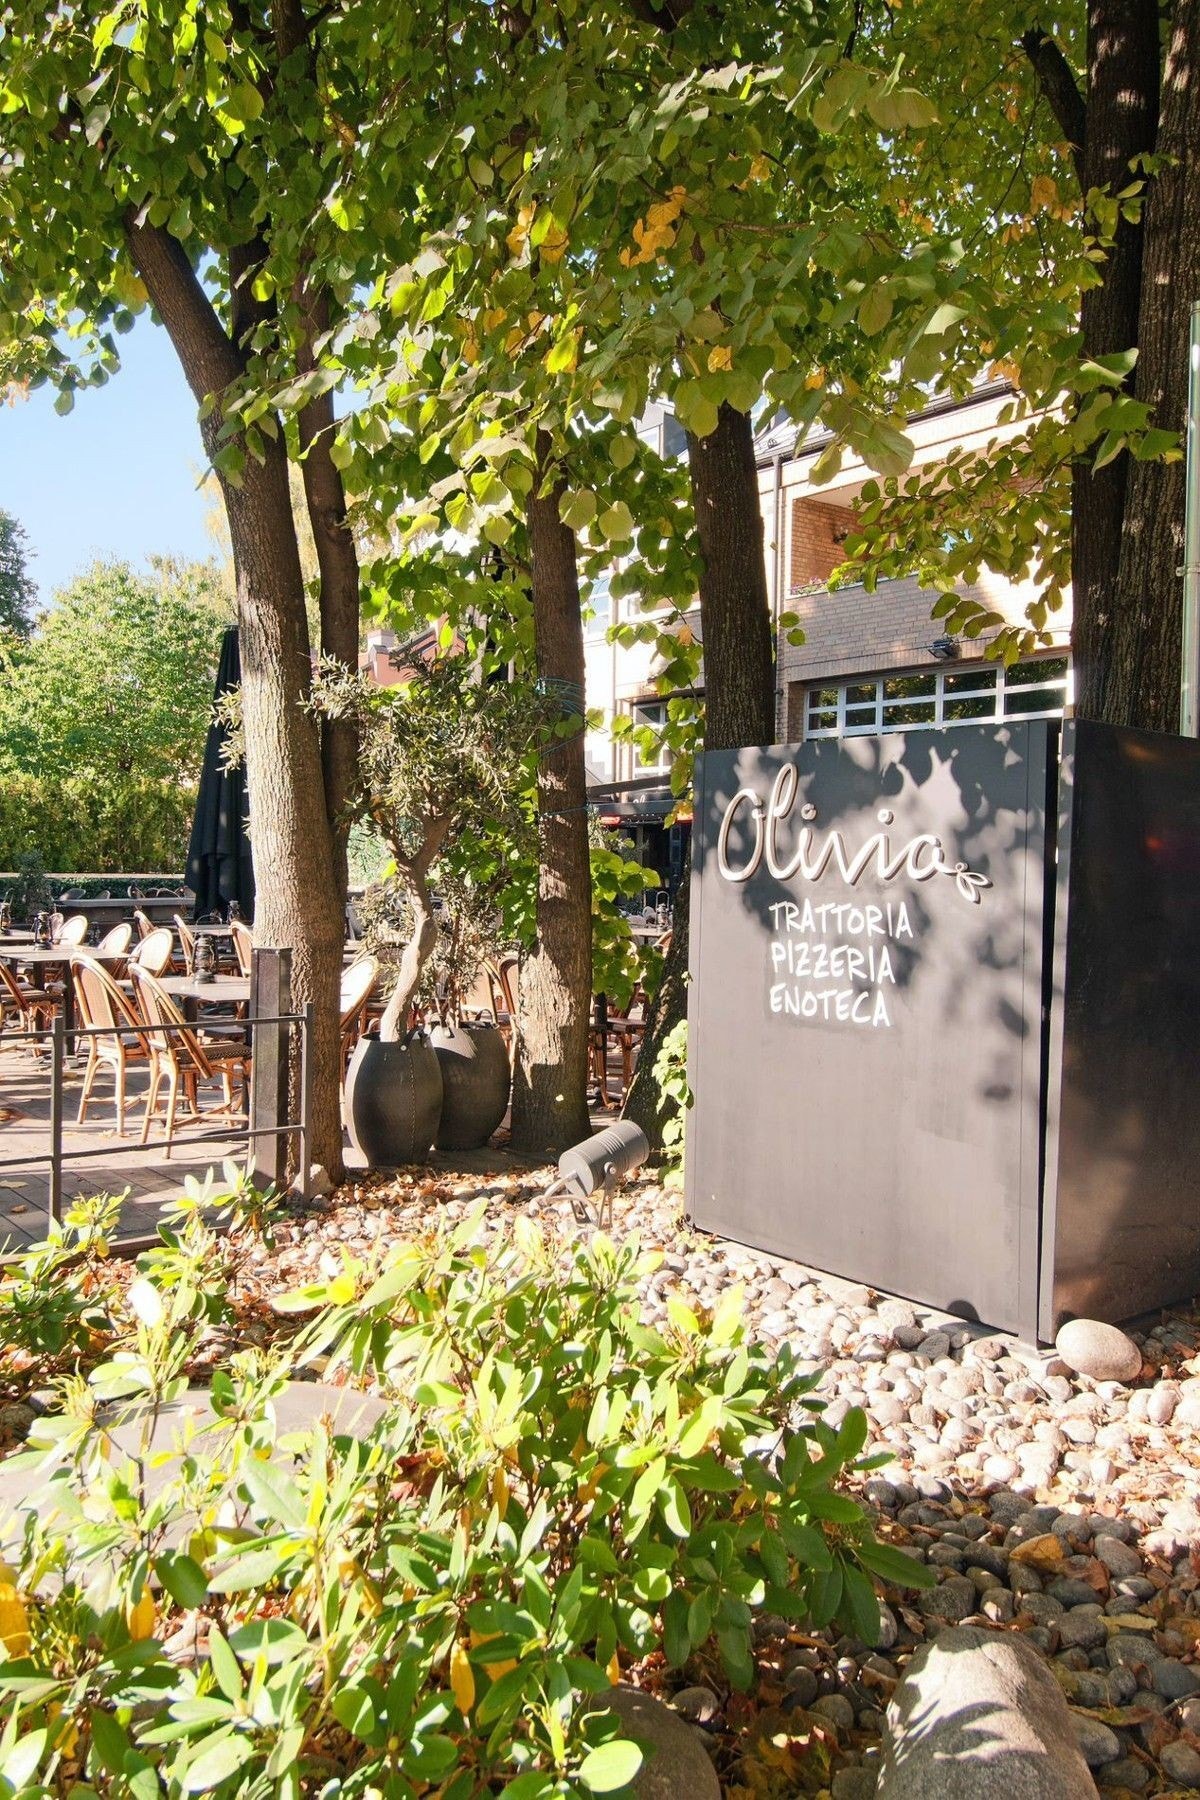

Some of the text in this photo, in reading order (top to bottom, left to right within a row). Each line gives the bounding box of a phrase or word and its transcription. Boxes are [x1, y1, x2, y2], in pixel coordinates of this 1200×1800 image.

[718, 763, 955, 885] Olivia
[768, 898, 913, 938] TRATTORIA
[771, 940, 896, 983] PIZZERIA
[769, 983, 890, 1027] ENOTECA
